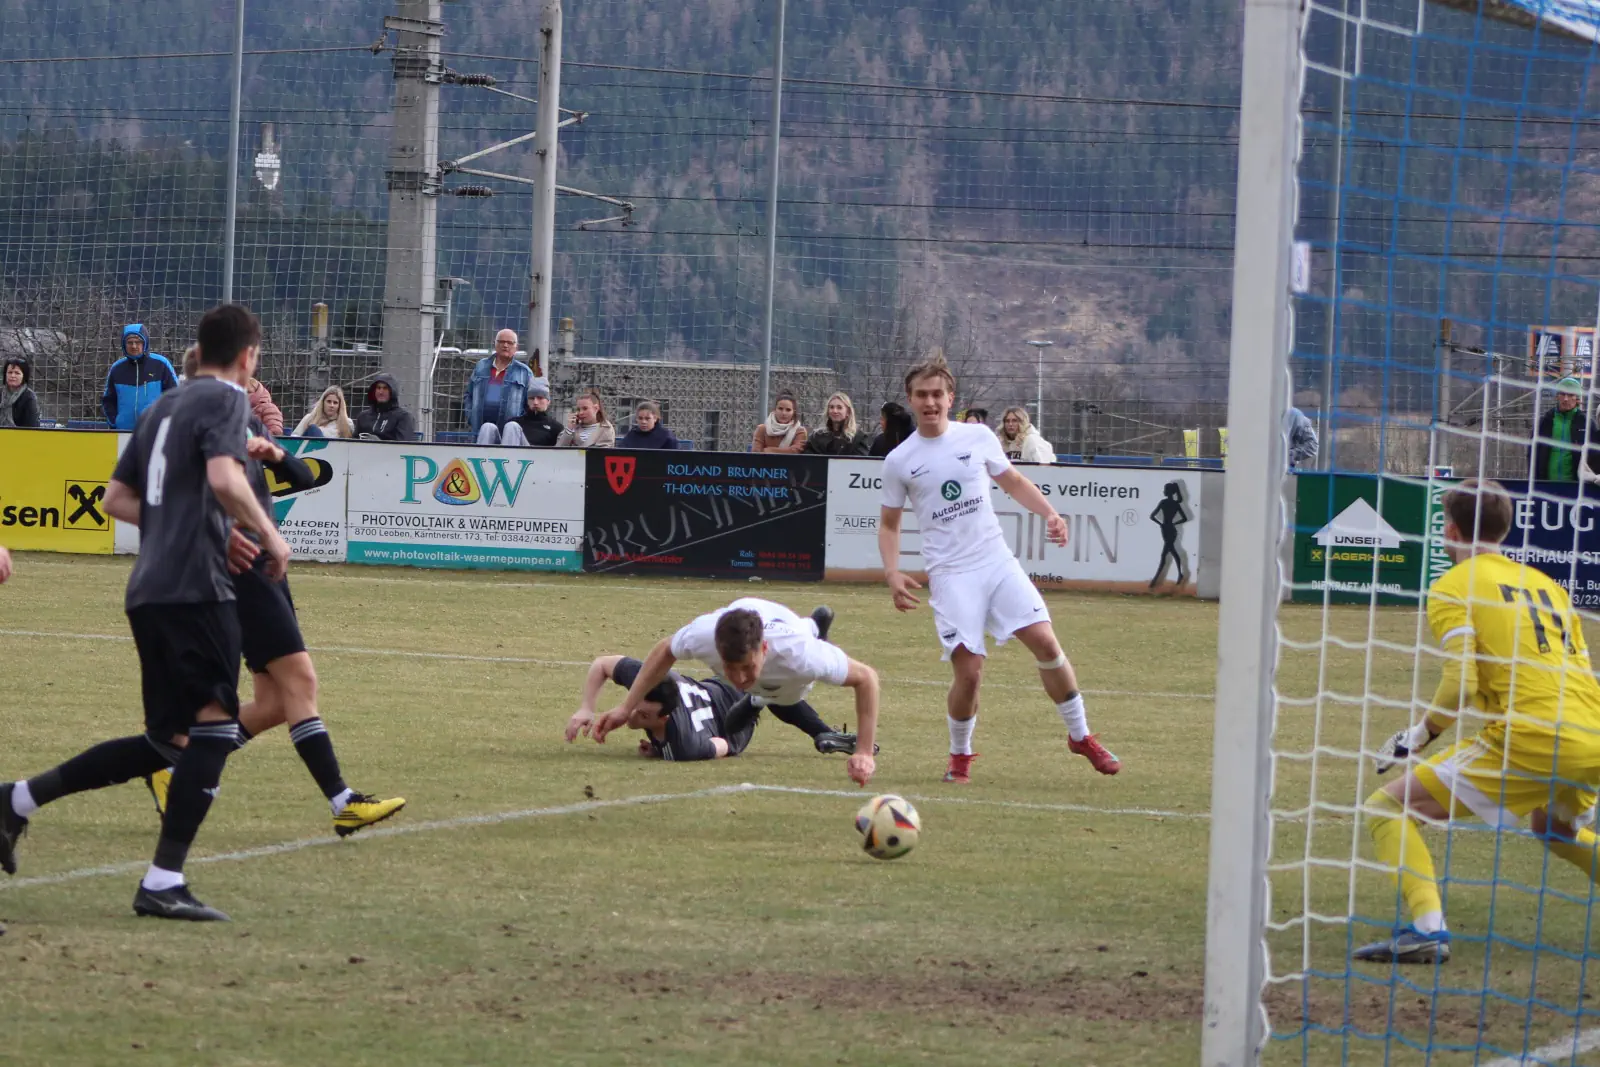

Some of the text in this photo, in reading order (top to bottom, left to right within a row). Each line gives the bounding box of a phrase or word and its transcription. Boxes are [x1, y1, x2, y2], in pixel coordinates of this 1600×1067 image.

[667, 464, 788, 479] ROLAND BRUNNER
[664, 483, 789, 498] THOMAS BRUNNER
[1058, 482, 1140, 499] verlieren
[295, 520, 340, 529] LEOBEN
[362, 514, 569, 533] PHOTOVOLTAIK & WÄRMEPUMPEN
[586, 468, 825, 568] BRUNNER
[842, 517, 876, 528] AUER
[301, 537, 316, 545] Fax:
[354, 528, 377, 536] 8700
[501, 534, 562, 545] 03842/42432
[564, 537, 577, 545] 20
[1334, 536, 1383, 545] UNSER
[291, 546, 339, 555] old.co.at
[364, 549, 566, 566] www.photovoltaik-waermepumpen.at
